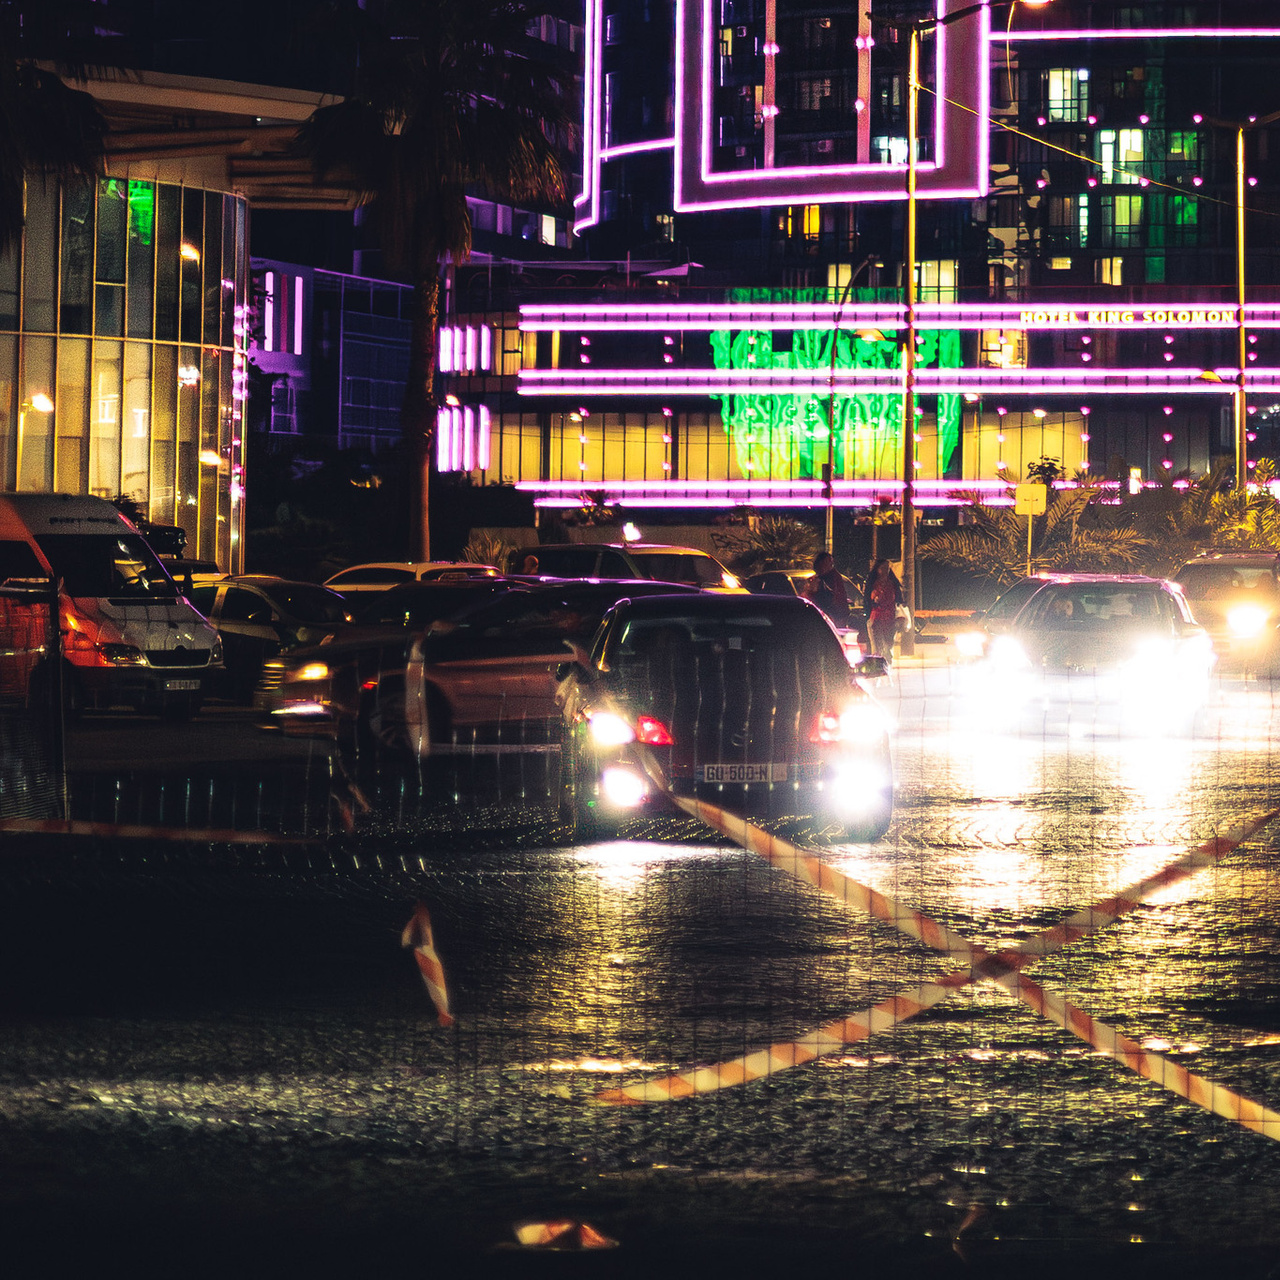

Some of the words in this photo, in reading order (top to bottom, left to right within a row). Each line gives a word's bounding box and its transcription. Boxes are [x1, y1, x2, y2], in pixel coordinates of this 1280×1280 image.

[1020, 311, 1079, 325] HOTEL
[1088, 311, 1134, 324] KING
[1142, 310, 1234, 324] SOLOMON
